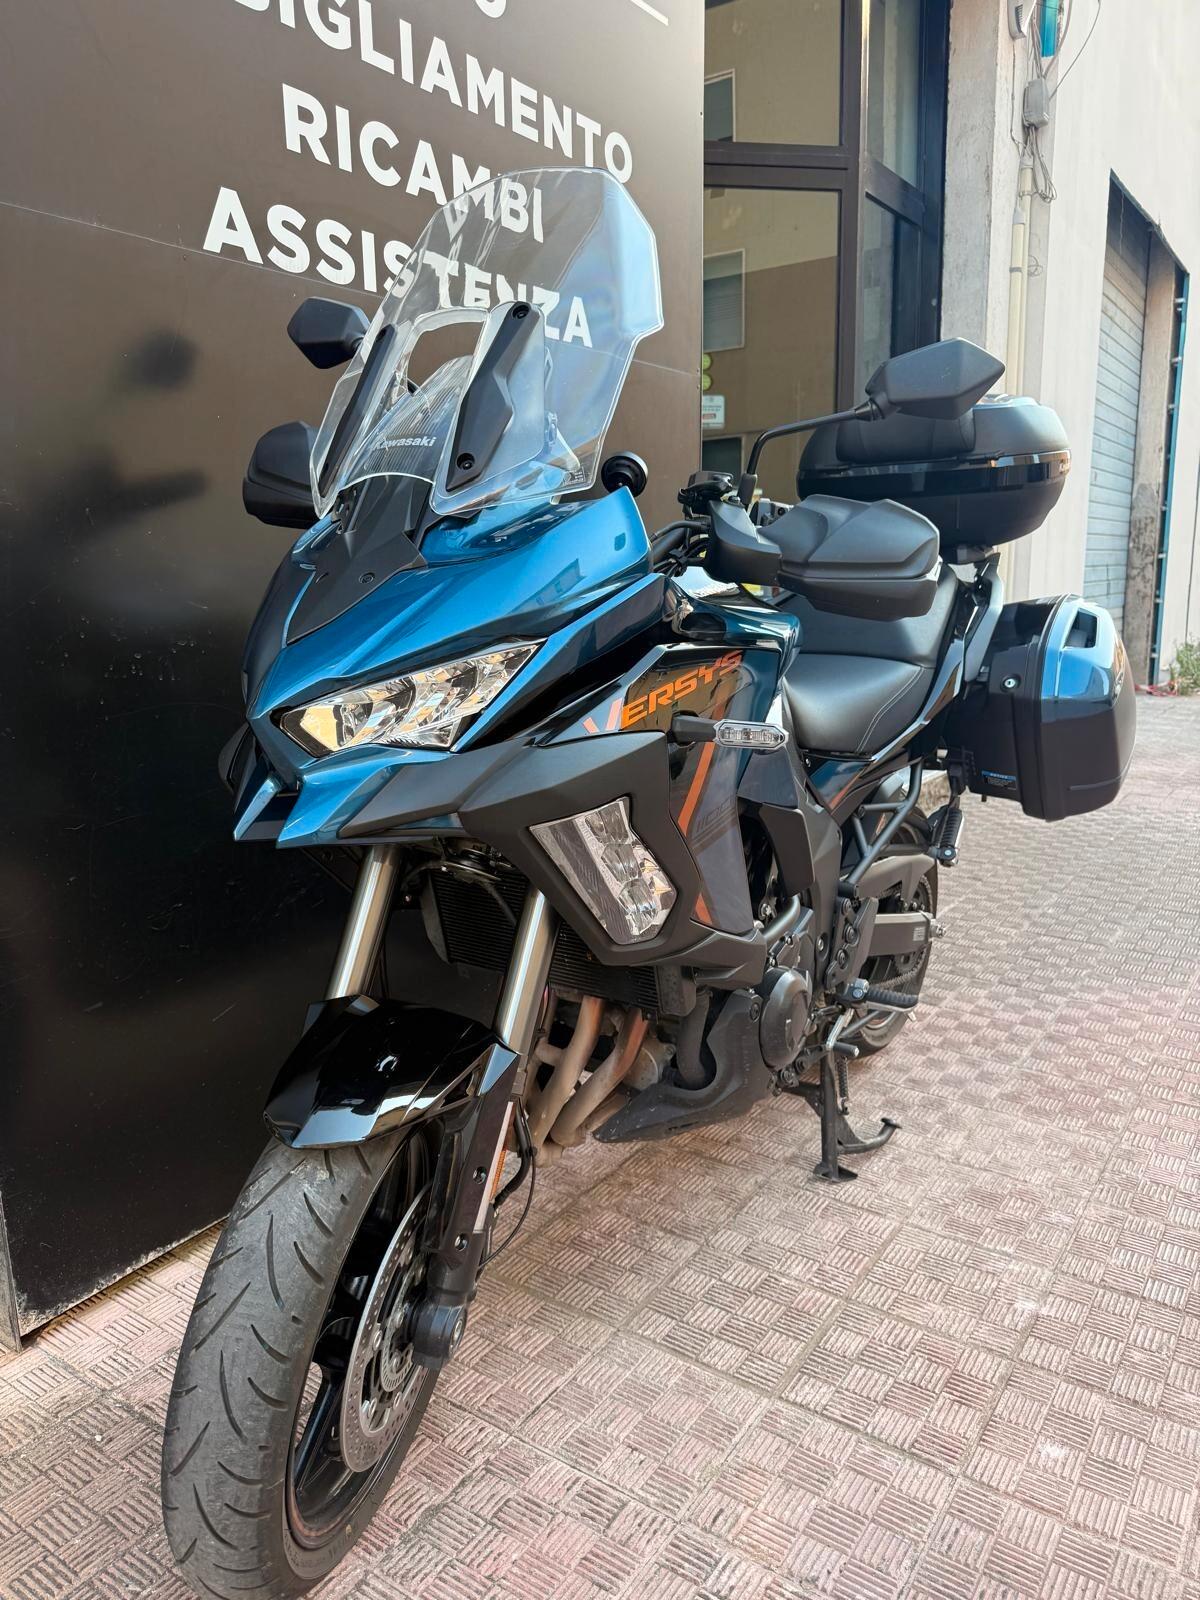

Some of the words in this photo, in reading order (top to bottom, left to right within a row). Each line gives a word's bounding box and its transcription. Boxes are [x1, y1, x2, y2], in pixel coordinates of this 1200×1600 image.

[234, 0, 633, 184] GLIAMENTO
[281, 83, 545, 243] RICAMBI
[374, 436, 438, 450] Kawasaki
[583, 650, 743, 735] VERSYS
